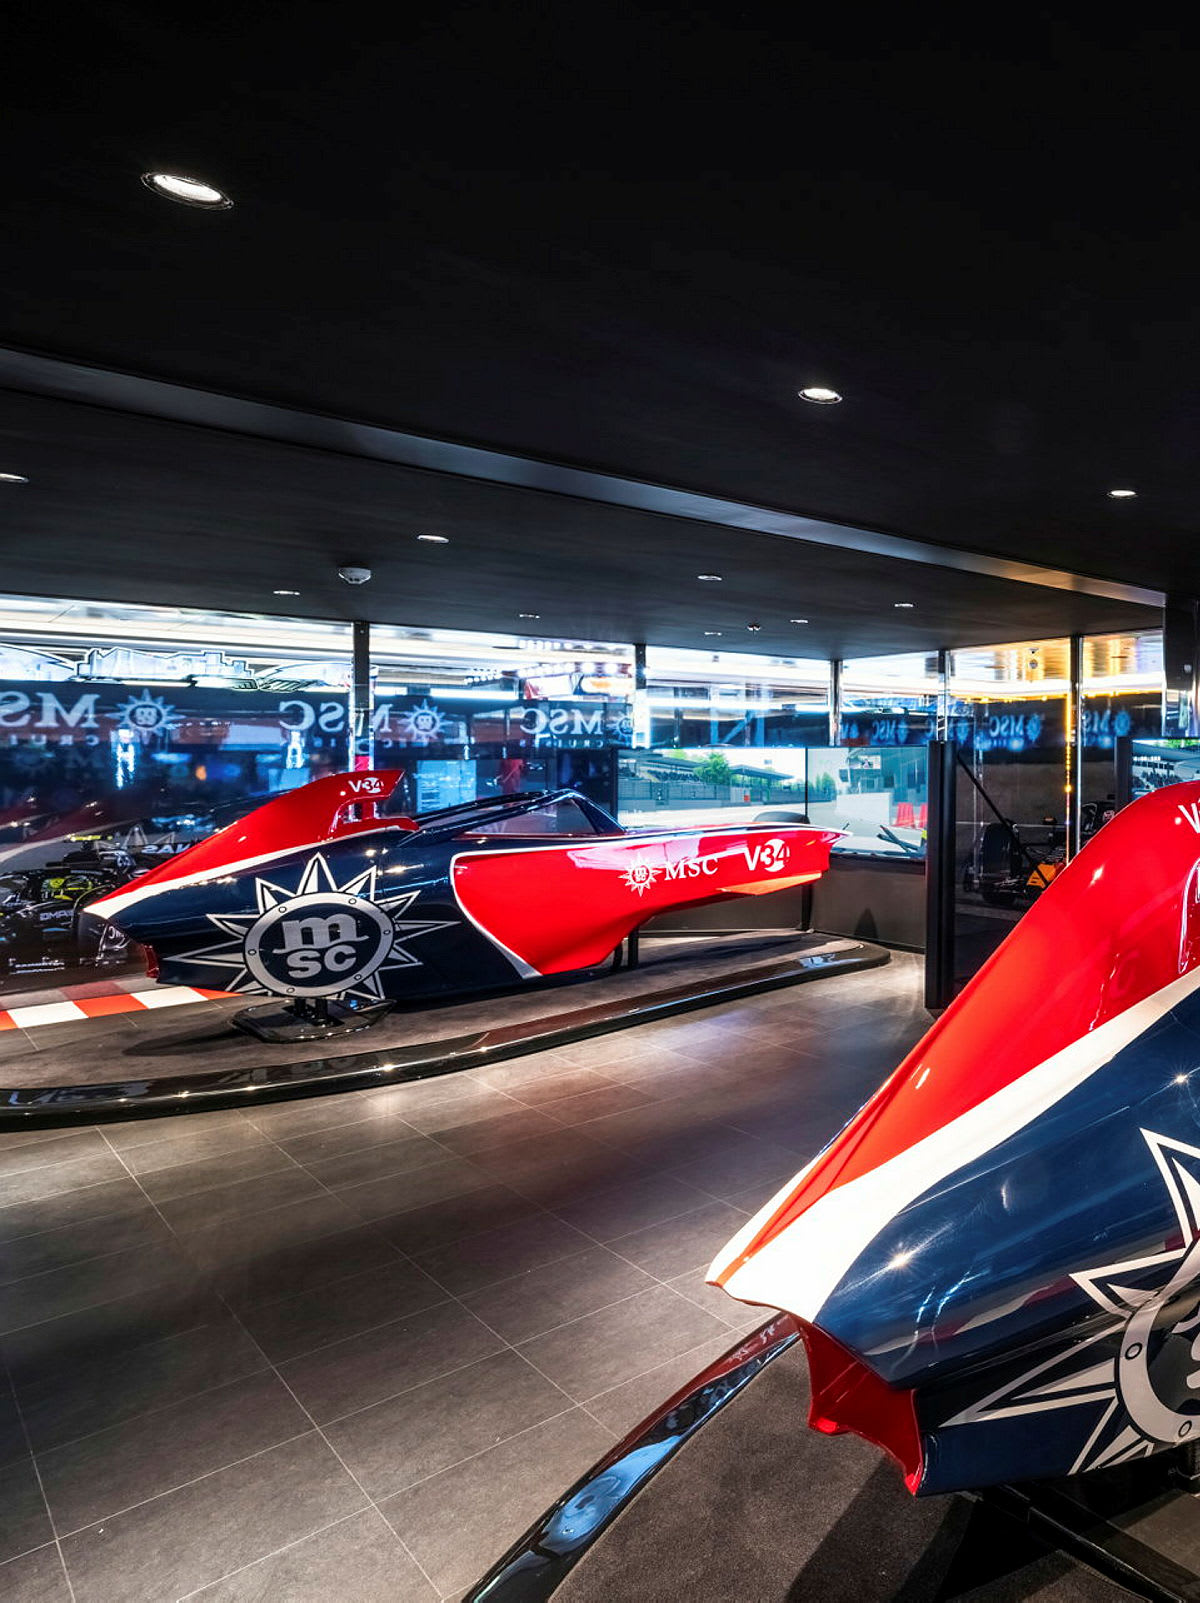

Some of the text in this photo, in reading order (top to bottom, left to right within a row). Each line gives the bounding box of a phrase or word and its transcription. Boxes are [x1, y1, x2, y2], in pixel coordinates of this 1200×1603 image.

[349, 777, 384, 793] V34
[664, 839, 790, 881] MSC V34
